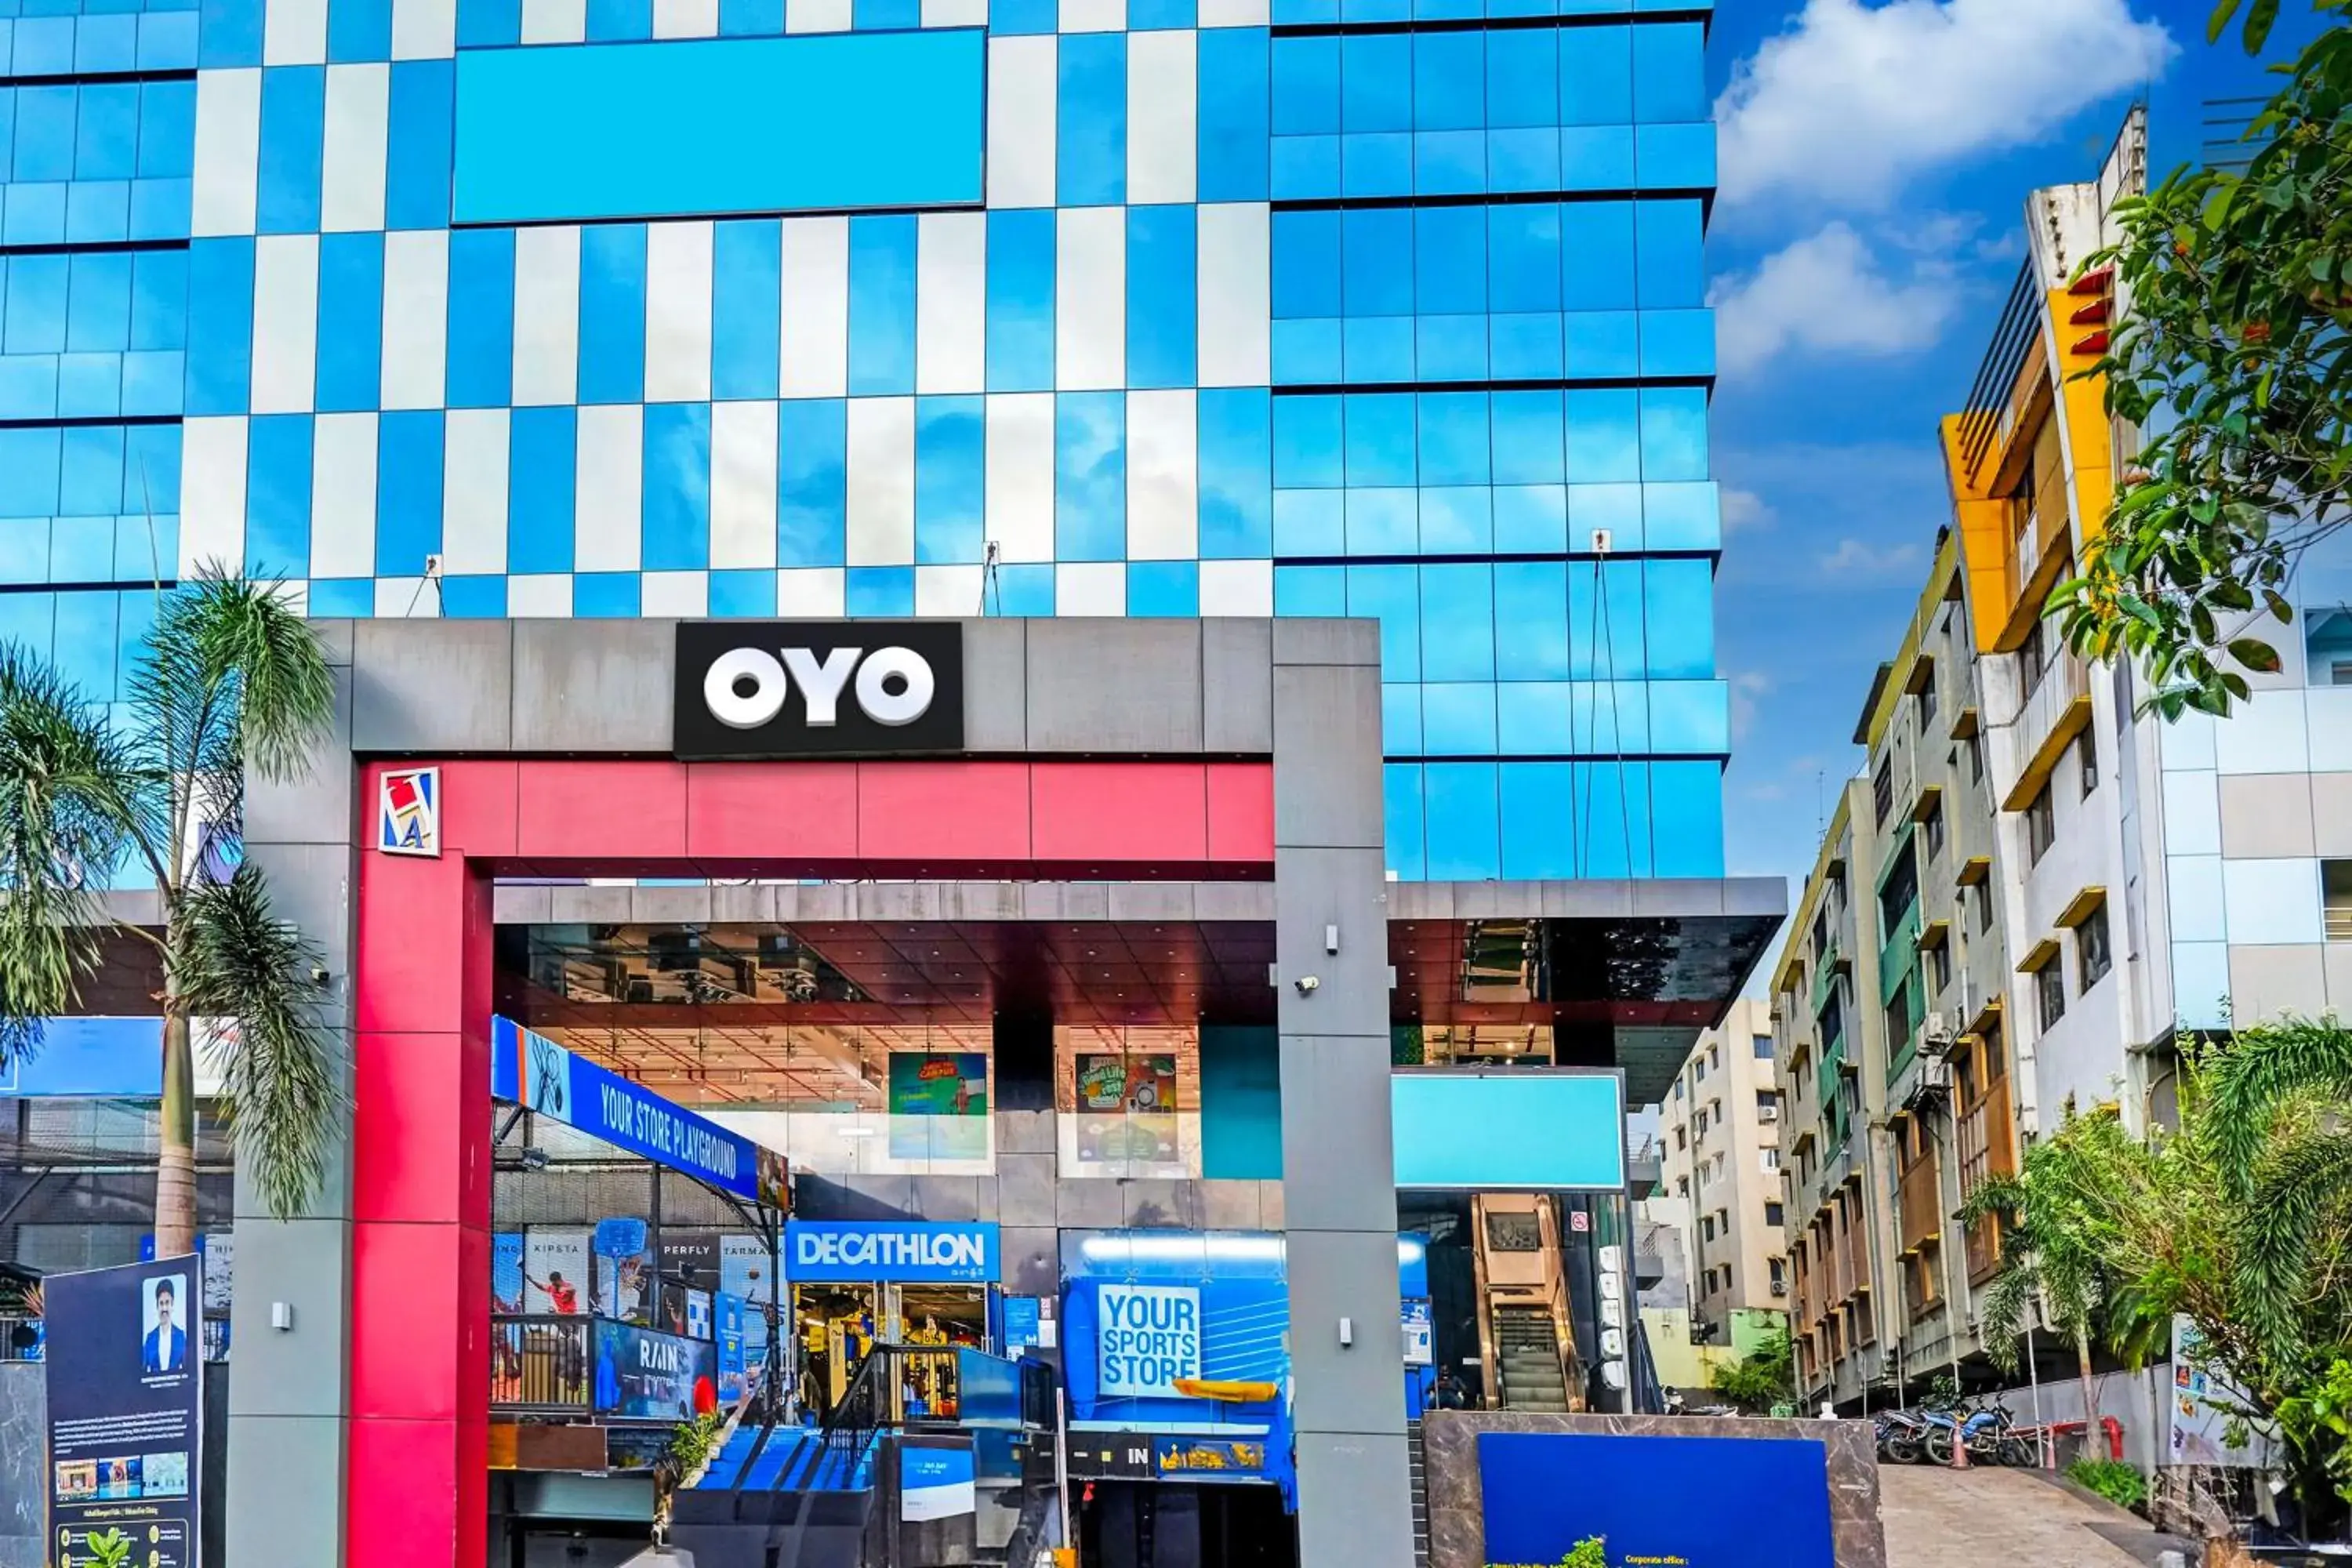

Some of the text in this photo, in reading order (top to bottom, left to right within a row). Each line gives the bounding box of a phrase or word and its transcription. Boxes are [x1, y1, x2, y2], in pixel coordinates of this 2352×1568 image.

[703, 646, 935, 729] OYO
[601, 1083, 737, 1180] YOUR STORE PLAYGROUND
[664, 1246, 710, 1256] PERFLY
[797, 1232, 985, 1267] DECATHLON
[1105, 1294, 1196, 1331] YOUR
[640, 1338, 679, 1372] RAIN
[1104, 1330, 1196, 1356] SPORTS
[1128, 1448, 1149, 1465] IN
[1625, 1555, 1662, 1566] Corporate
